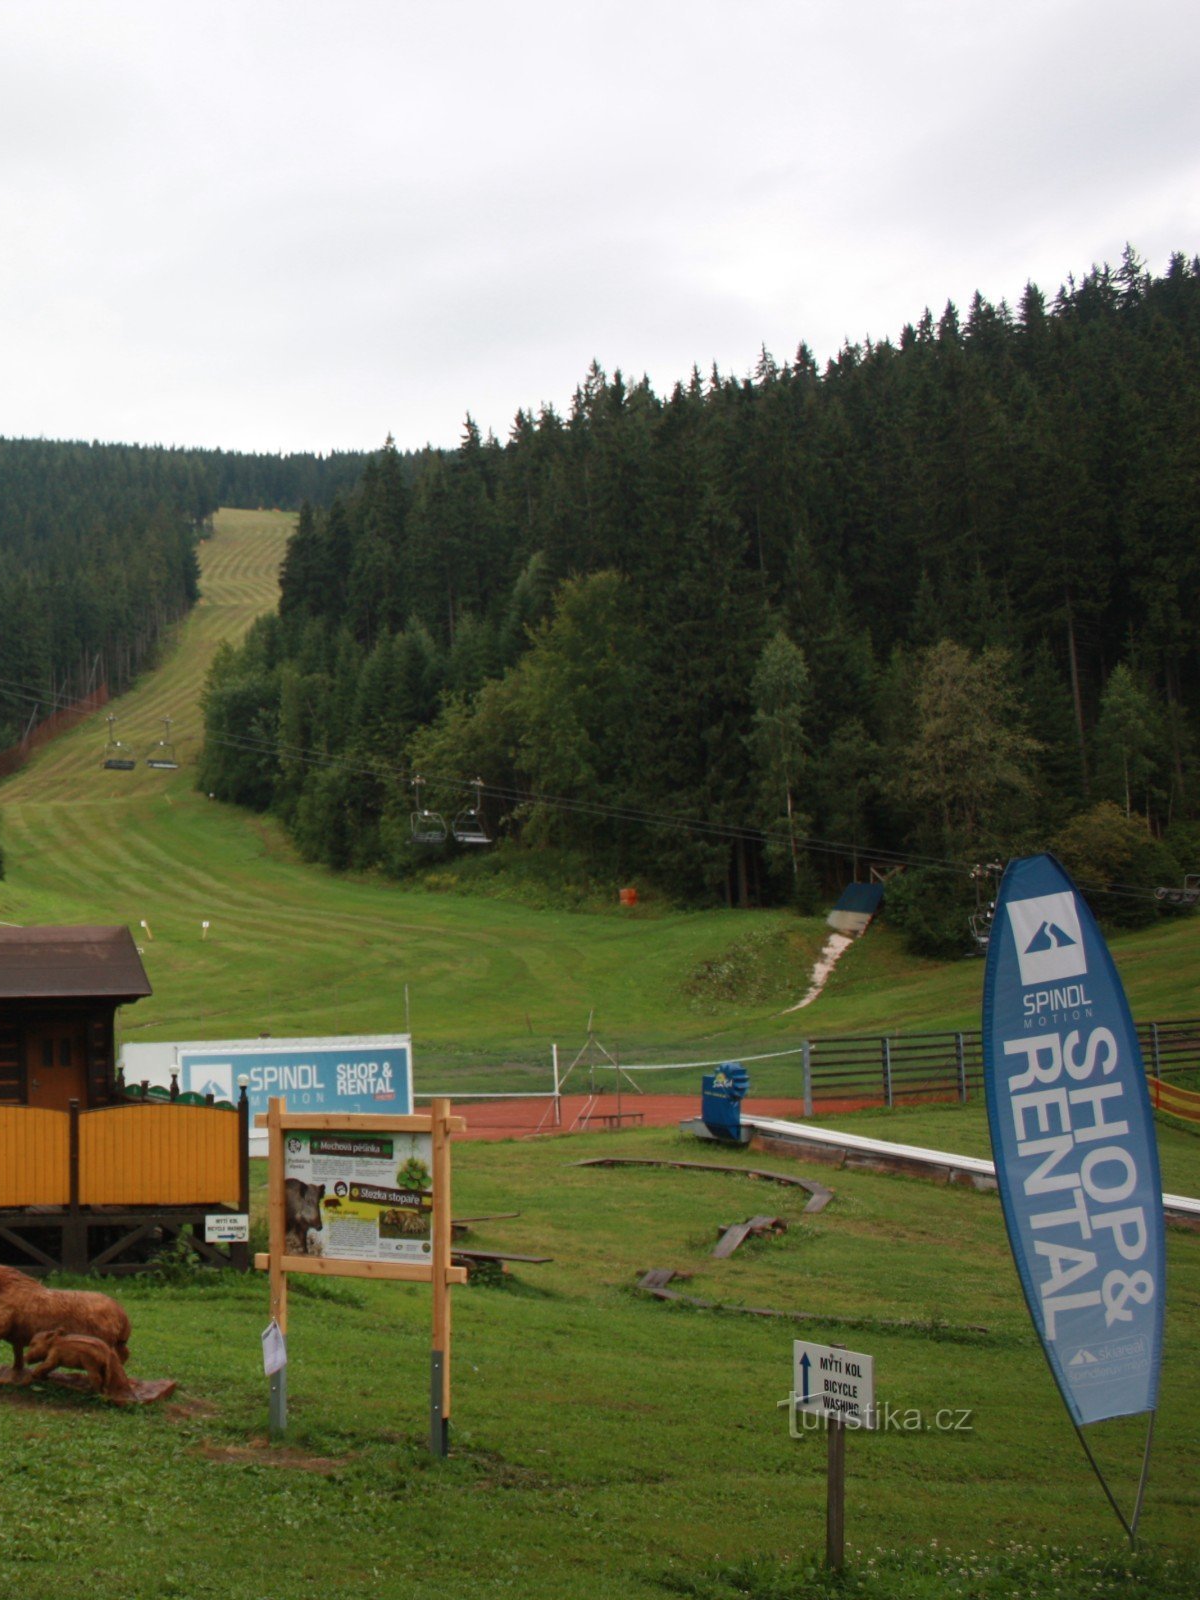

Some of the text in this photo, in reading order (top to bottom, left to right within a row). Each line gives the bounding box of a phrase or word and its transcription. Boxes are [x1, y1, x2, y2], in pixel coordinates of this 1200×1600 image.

[1023, 984, 1092, 1016] SPINDL
[1023, 1008, 1093, 1029] MOTION
[250, 1064, 325, 1092] SPINDL
[336, 1062, 393, 1081] SHOP &
[337, 1076, 395, 1095] RENTAL
[250, 1092, 325, 1107] MION
[320, 1141, 381, 1153] Mechová pěšinka
[1003, 1032, 1104, 1341] RENTAL
[1062, 1027, 1155, 1327] SHOP &
[360, 1188, 420, 1204] Stezka stopaře
[845, 1362, 862, 1378] KOL
[824, 1379, 858, 1398] BICYCLE
[823, 1396, 860, 1416] WASHING
